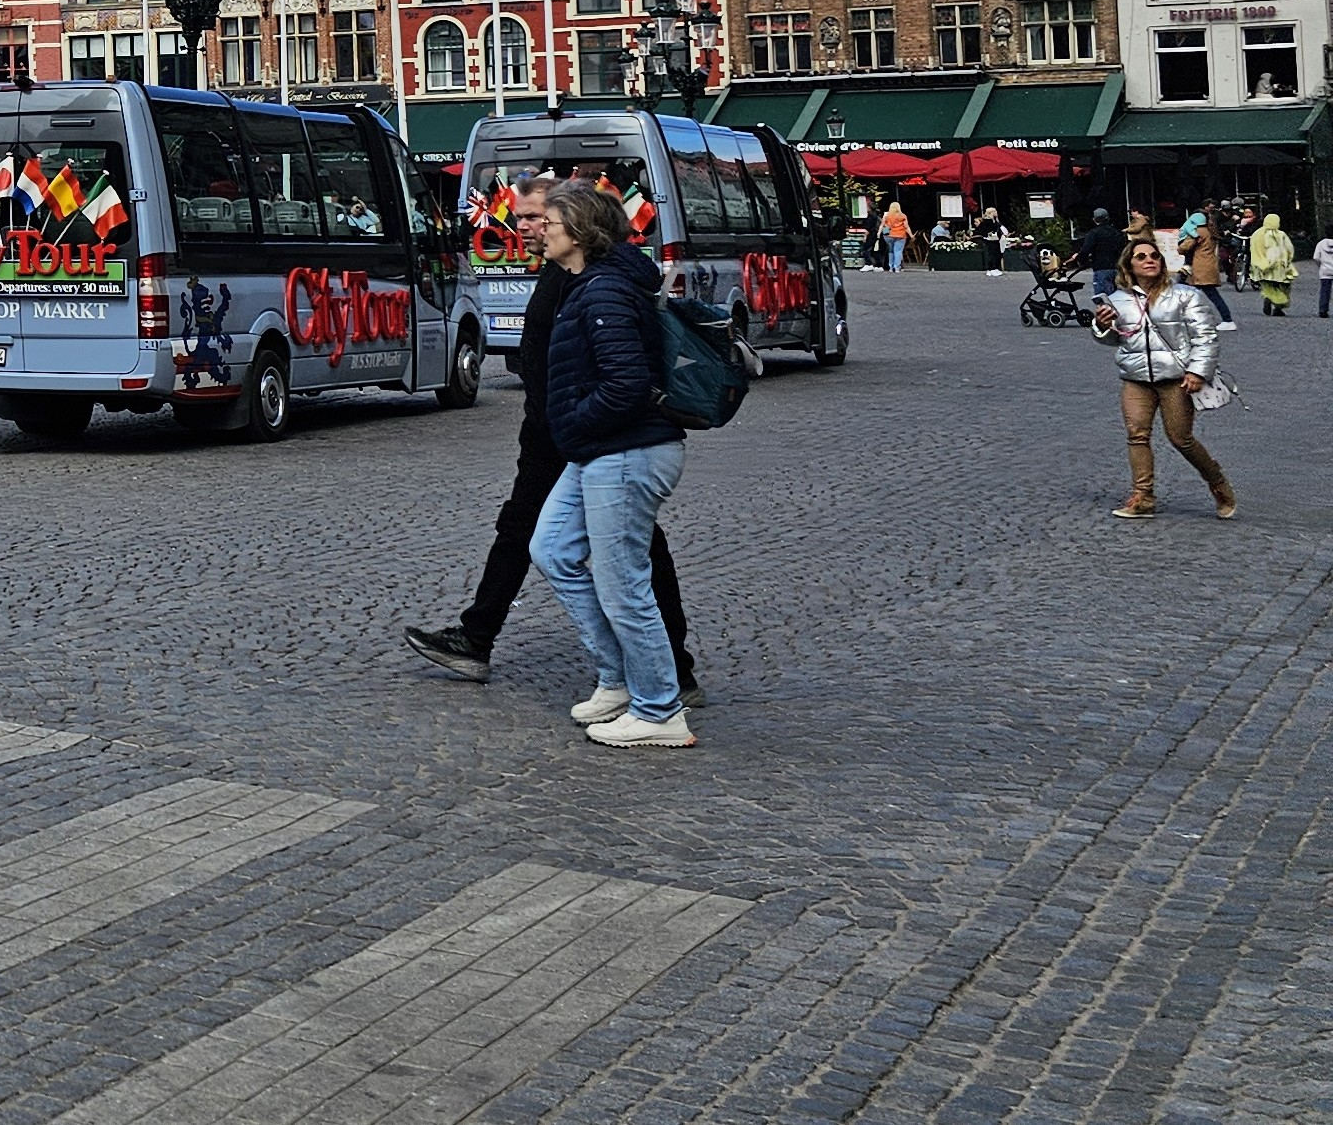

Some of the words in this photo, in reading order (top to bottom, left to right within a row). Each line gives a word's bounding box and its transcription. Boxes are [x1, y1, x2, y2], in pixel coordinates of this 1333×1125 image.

[1169, 7, 1238, 22] FRITERIE
[875, 139, 941, 150] Restaurant
[997, 139, 1027, 149] Petit
[1031, 137, 1059, 149] café
[6, 229, 117, 277] Tour
[473, 266, 485, 275] 50
[506, 266, 527, 275] Tour
[53, 284, 81, 295] every
[82, 282, 96, 294] 30
[98, 282, 123, 294] min.
[32, 301, 109, 320] MARKT
[285, 266, 351, 368] City
[342, 270, 411, 343] Tour
